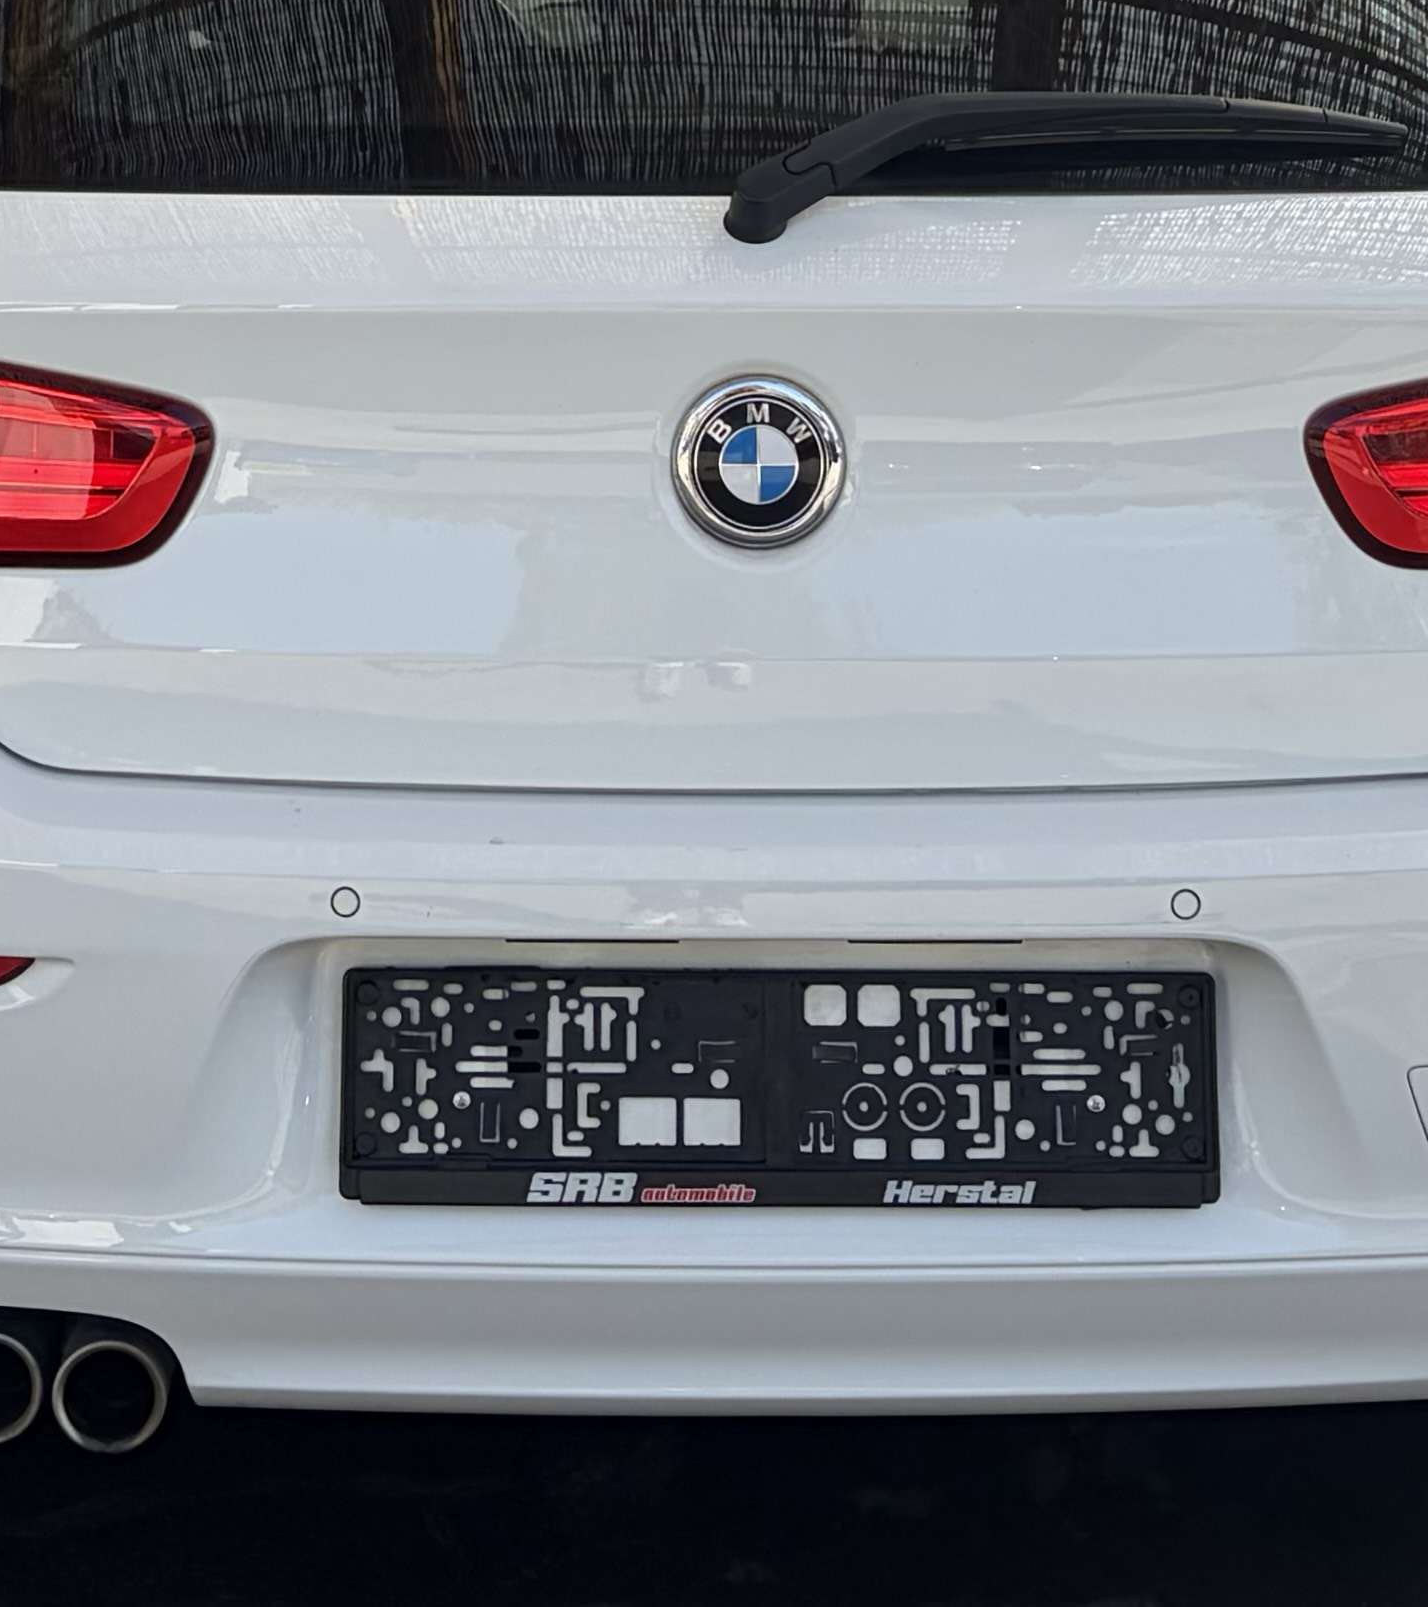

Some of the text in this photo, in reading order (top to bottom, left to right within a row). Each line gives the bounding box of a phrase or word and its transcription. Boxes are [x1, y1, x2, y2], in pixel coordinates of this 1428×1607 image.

[707, 403, 812, 444] BMW
[526, 1172, 1036, 1204] SRB automobile Herstal
